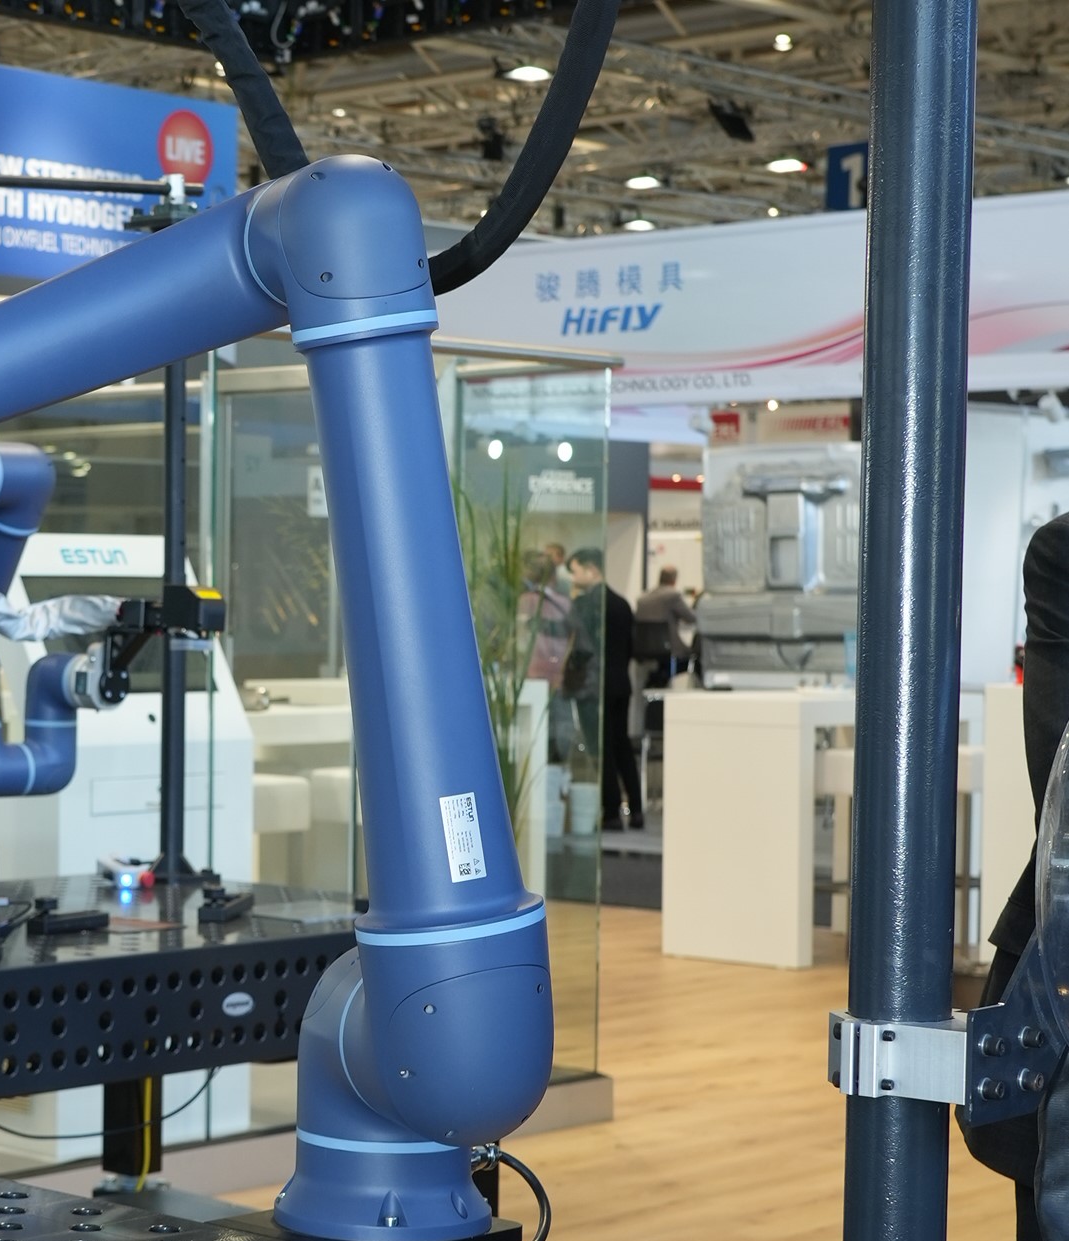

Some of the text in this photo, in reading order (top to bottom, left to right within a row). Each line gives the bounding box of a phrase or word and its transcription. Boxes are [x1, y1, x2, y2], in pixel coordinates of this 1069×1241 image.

[165, 136, 206, 165] LIVE
[27, 191, 135, 232] HYDROGE
[60, 548, 128, 566] ESTUN
[465, 796, 475, 822] ESTUN
